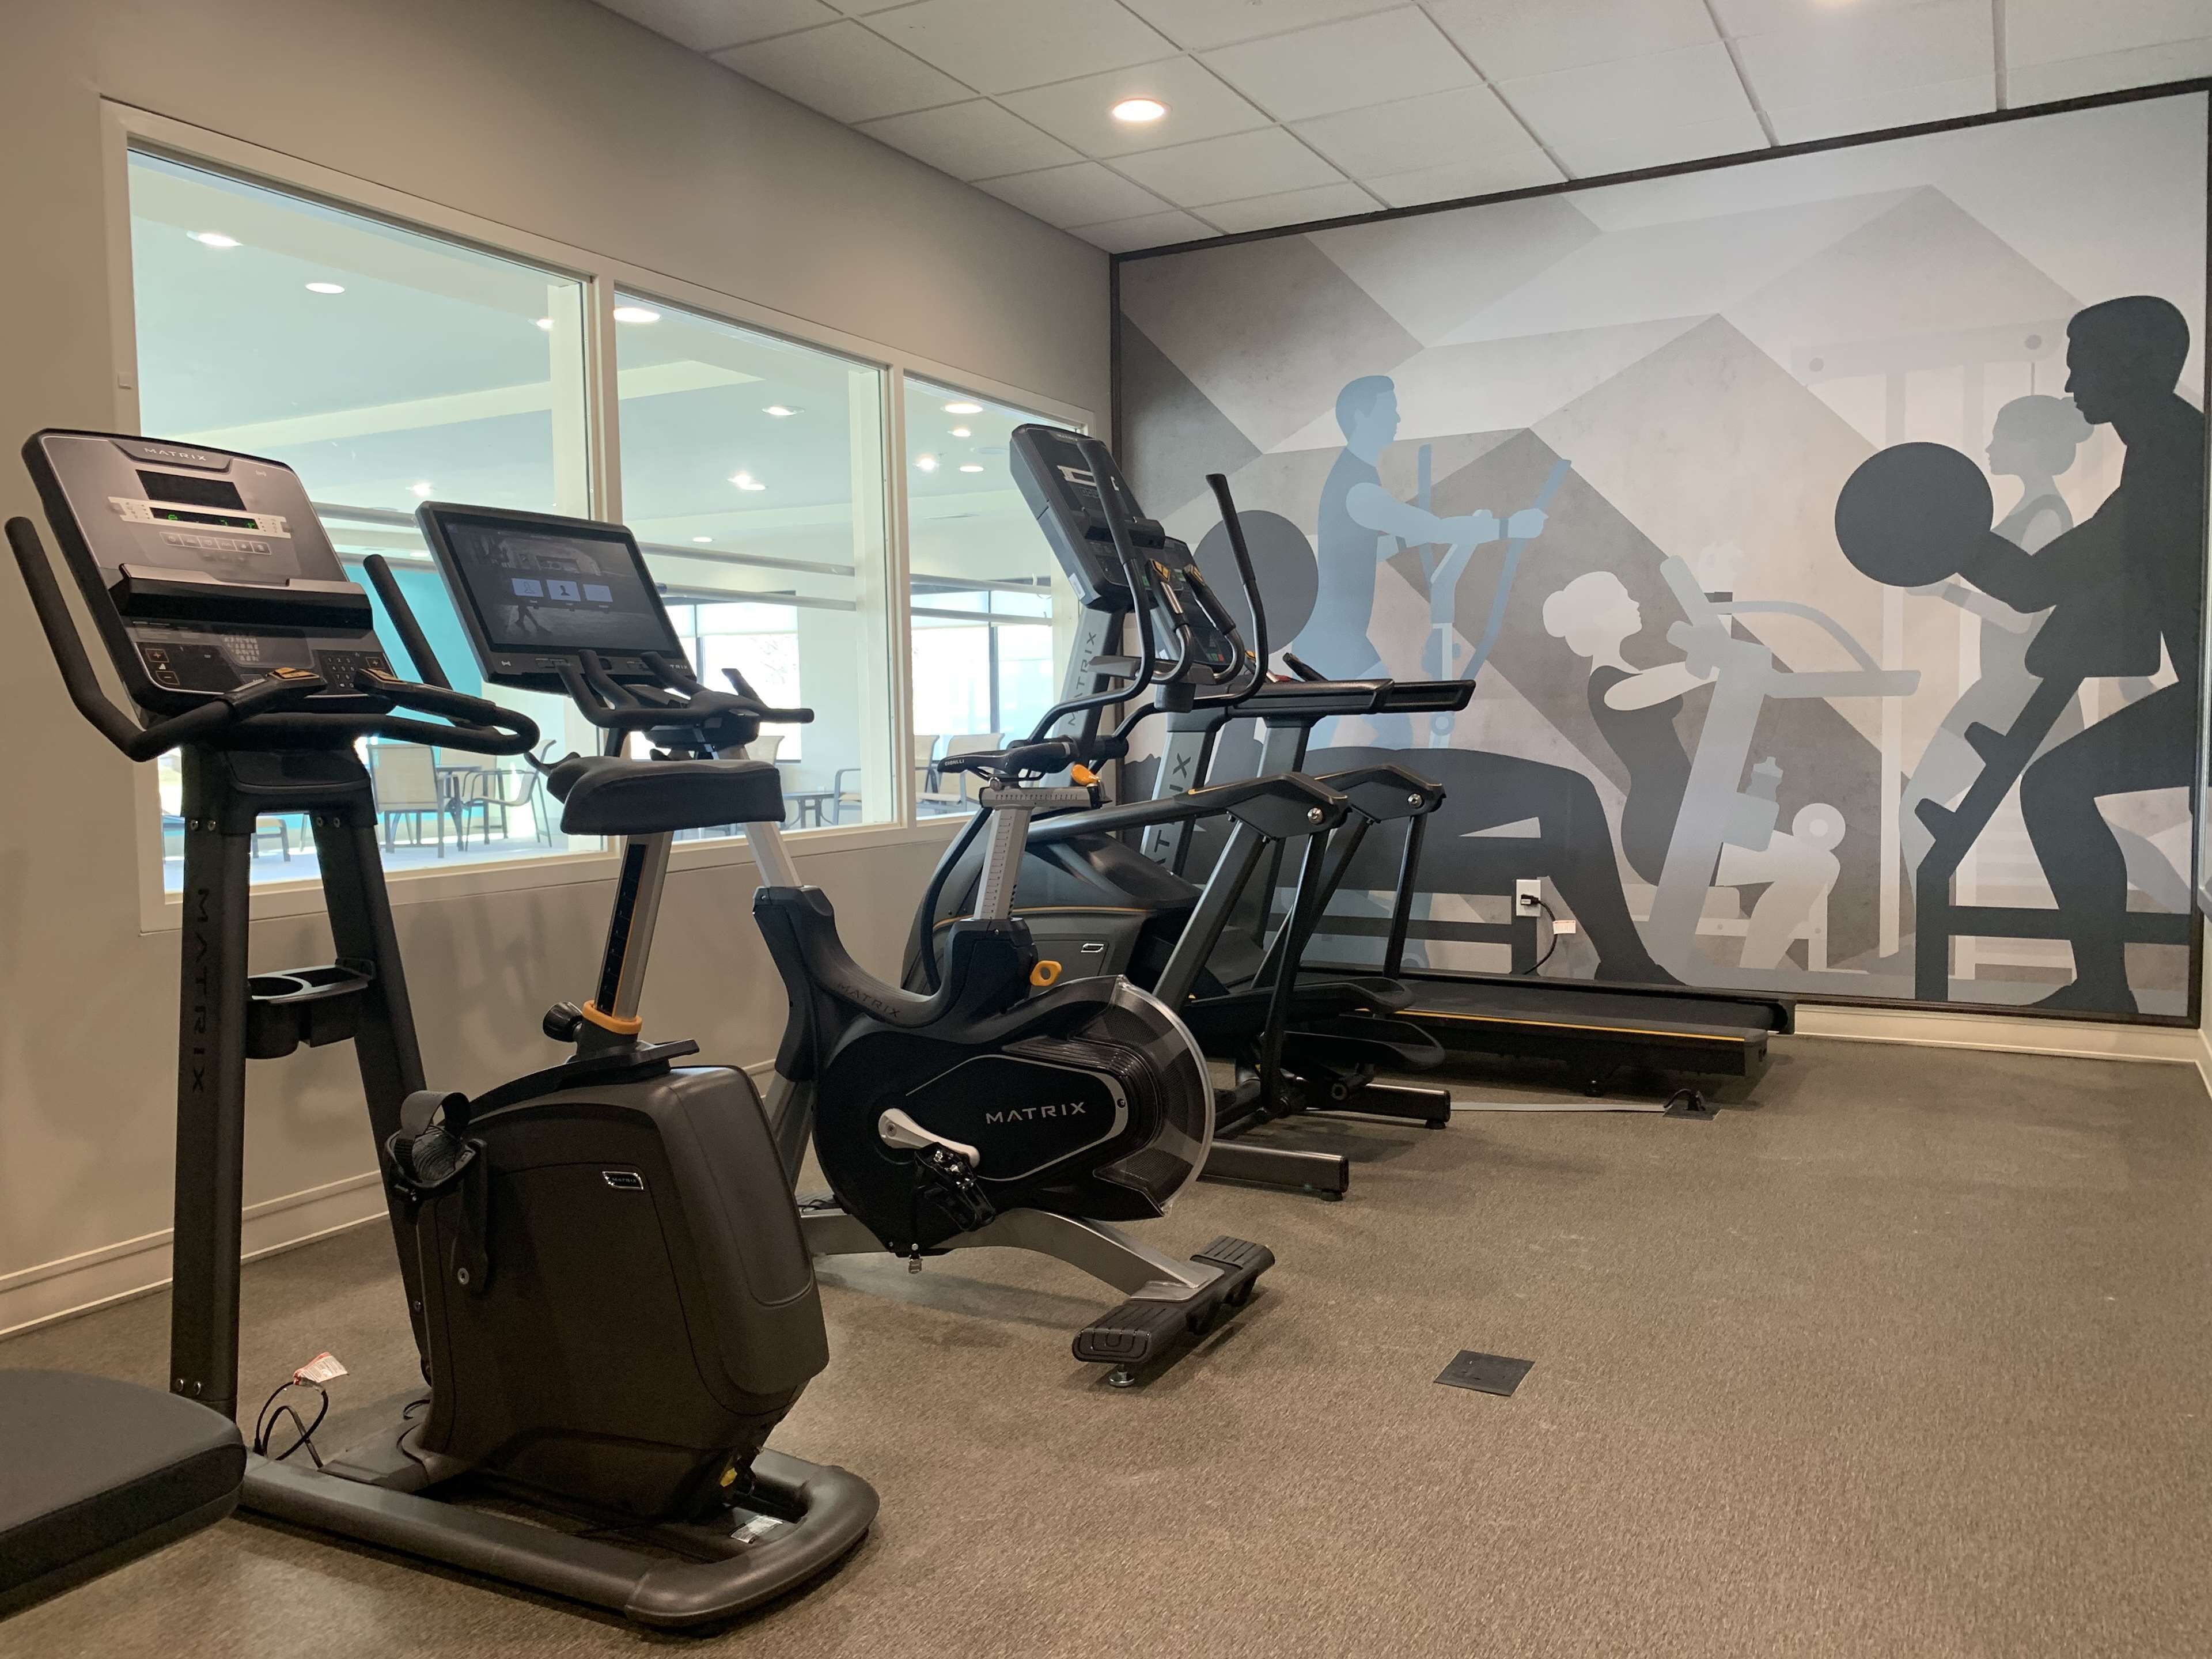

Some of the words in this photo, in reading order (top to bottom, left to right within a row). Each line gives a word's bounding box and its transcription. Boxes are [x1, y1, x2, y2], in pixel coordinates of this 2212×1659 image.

[144, 448, 206, 461] MATRIX
[192, 889, 209, 1093] MATRIX
[838, 982, 900, 1018] MATRIX
[986, 1101, 1086, 1124] MATRIX
